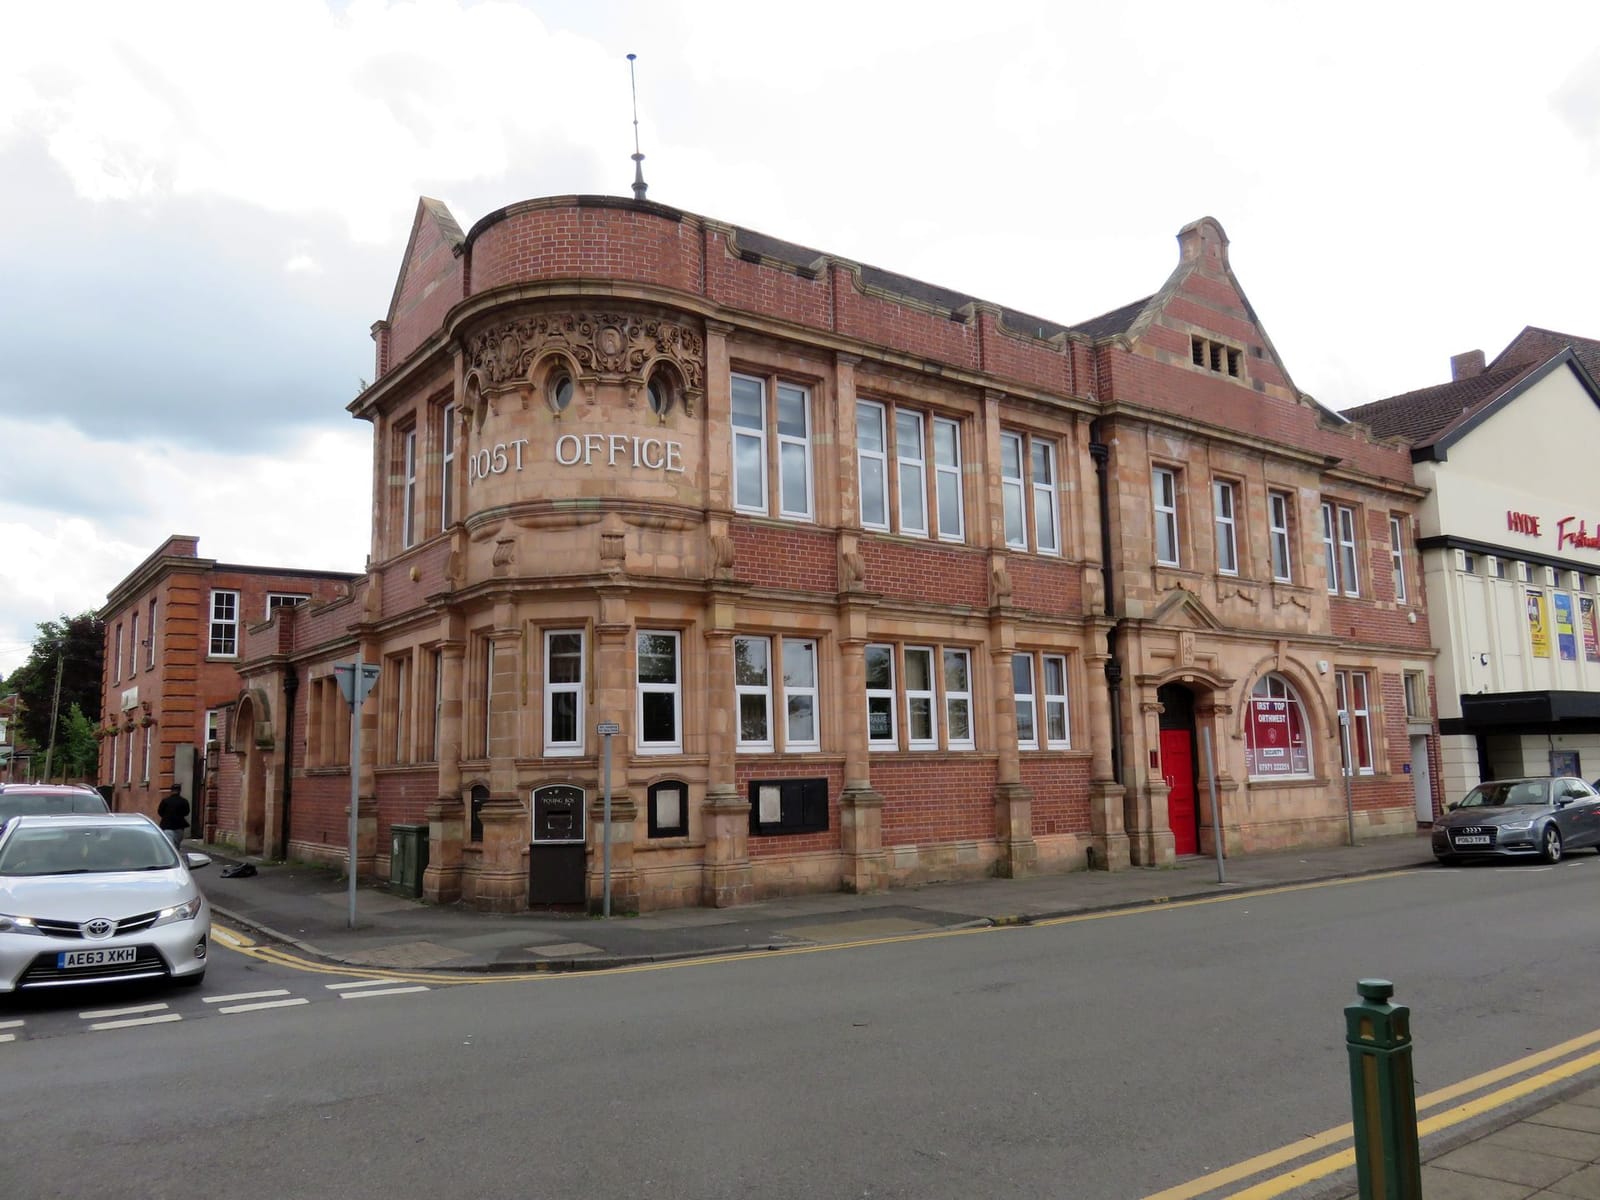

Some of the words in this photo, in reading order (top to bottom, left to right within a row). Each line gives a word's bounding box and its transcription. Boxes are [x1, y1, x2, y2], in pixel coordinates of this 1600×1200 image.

[468, 439, 529, 487] POST
[555, 433, 686, 473] OFFICE
[1507, 510, 1542, 537] HYDE
[68, 951, 104, 966] AE63
[108, 949, 135, 962] XKH
